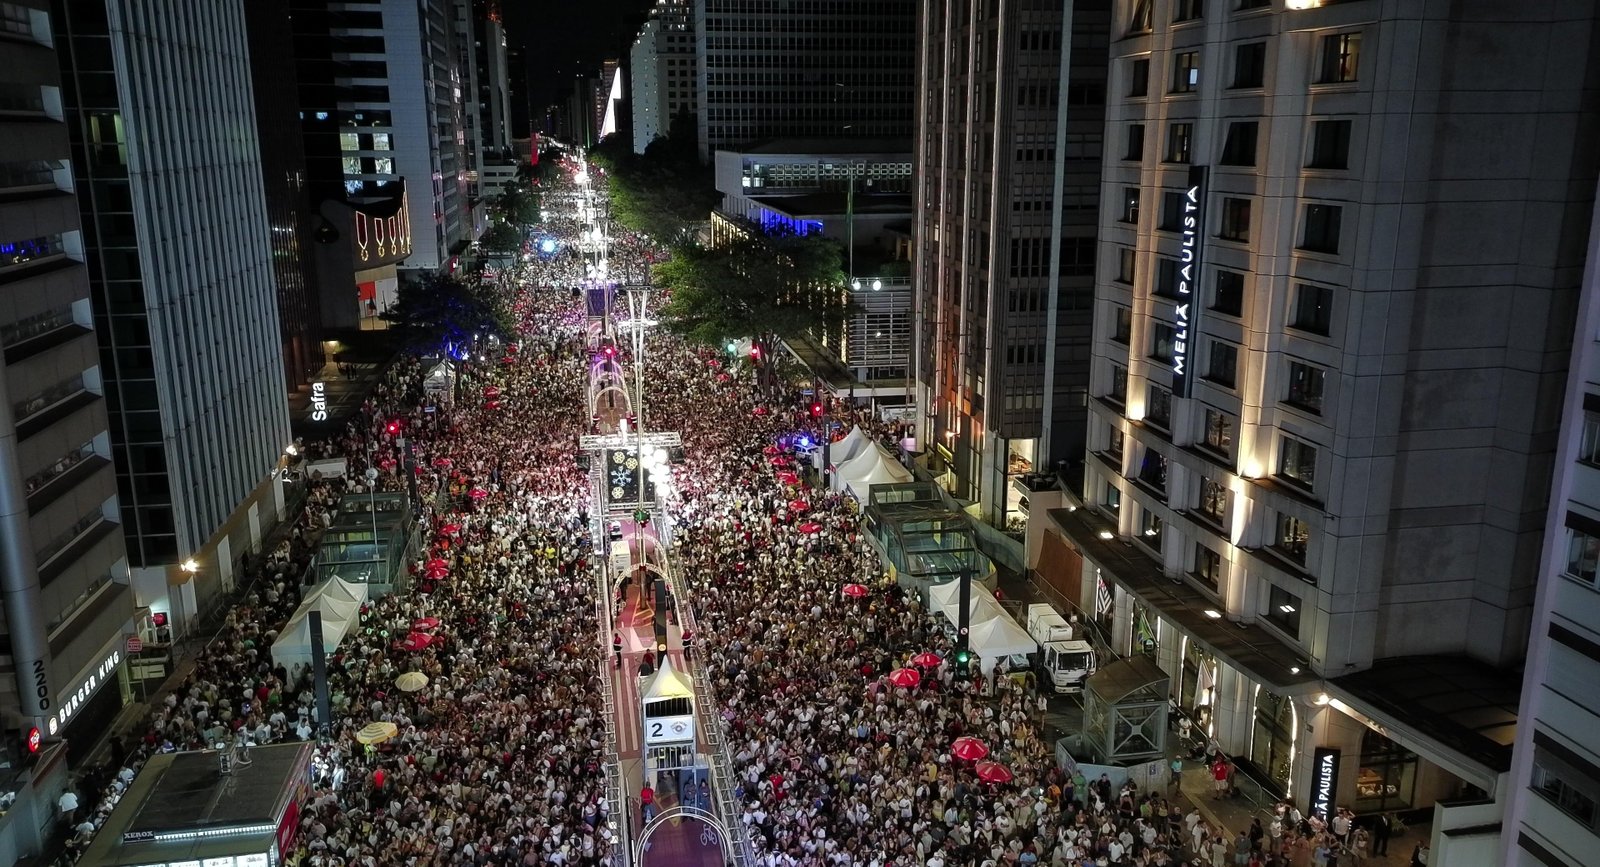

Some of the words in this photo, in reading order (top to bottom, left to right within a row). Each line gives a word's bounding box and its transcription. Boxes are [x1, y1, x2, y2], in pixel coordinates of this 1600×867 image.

[1179, 185, 1199, 294] PAULISTA
[310, 382, 327, 421] Safra
[33, 660, 50, 710] 2200
[59, 675, 96, 723] BURGER
[98, 650, 119, 680] KING
[651, 722, 664, 738] 2
[1318, 754, 1334, 801] PAULISTA
